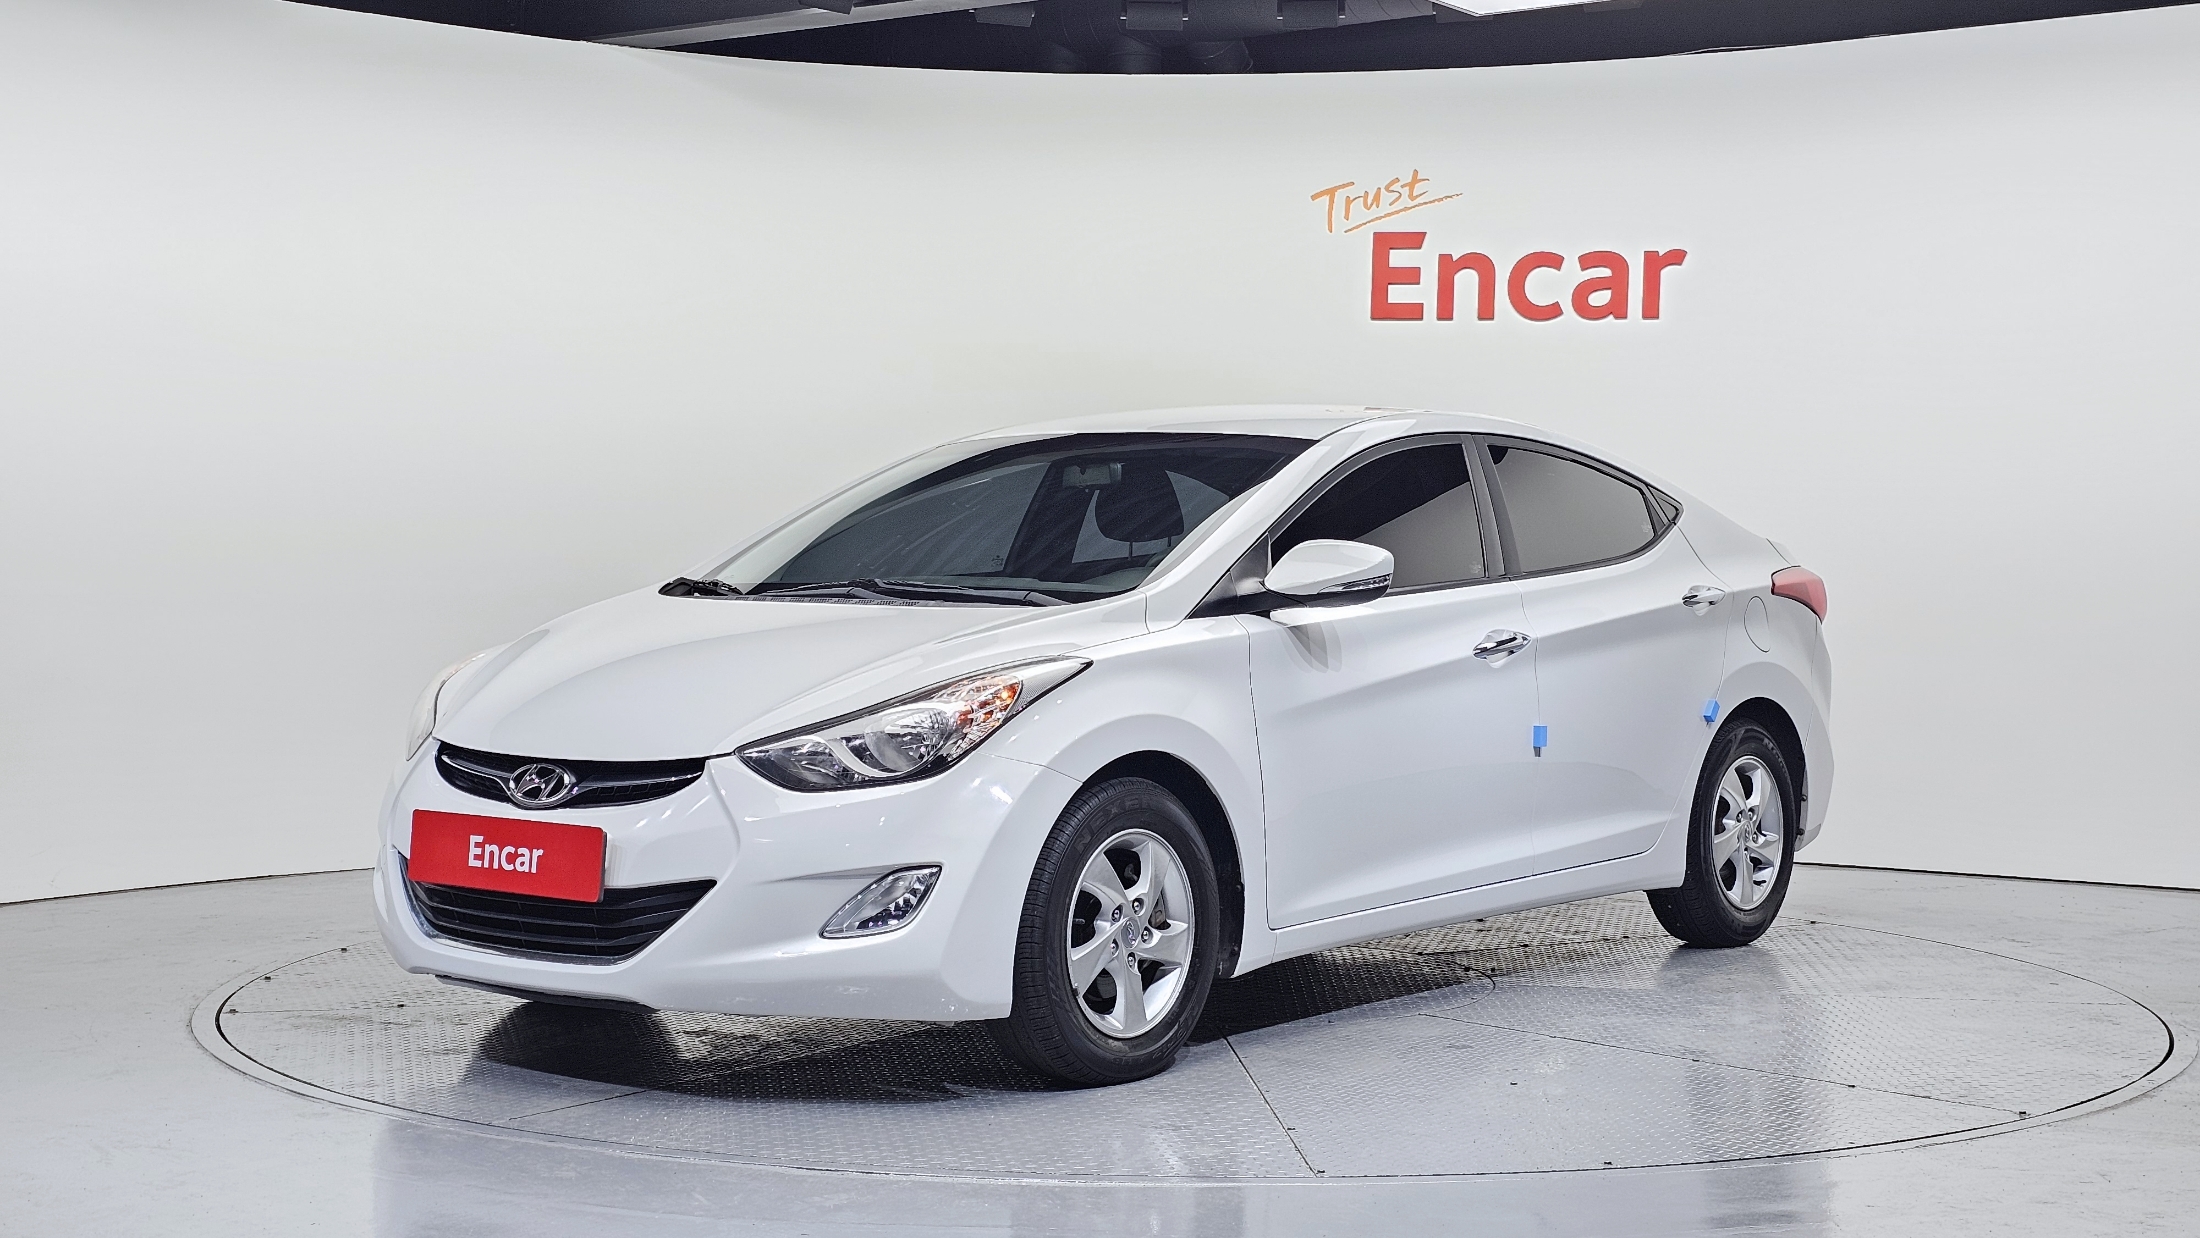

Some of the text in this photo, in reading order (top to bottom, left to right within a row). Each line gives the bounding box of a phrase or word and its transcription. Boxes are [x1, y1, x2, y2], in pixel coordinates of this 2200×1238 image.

[1310, 169, 1431, 233] Trust
[1370, 231, 1687, 321] Encar
[468, 834, 544, 874] Encar
